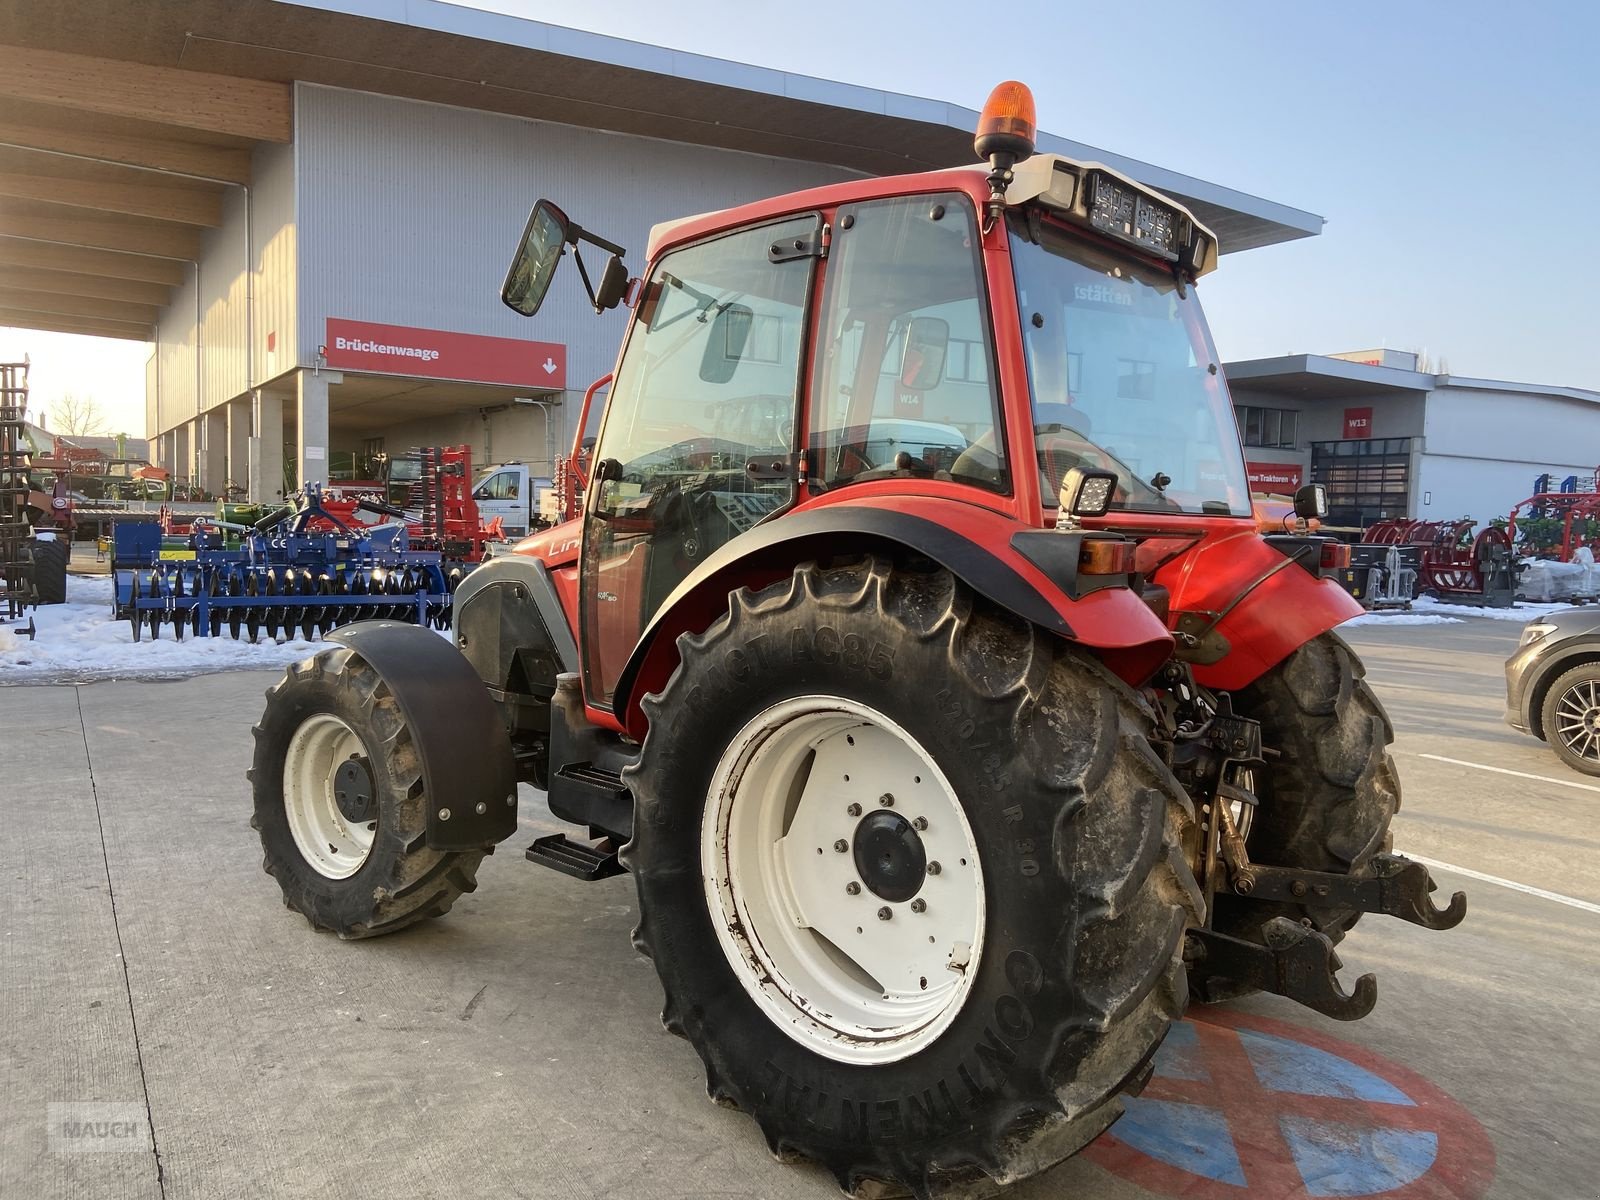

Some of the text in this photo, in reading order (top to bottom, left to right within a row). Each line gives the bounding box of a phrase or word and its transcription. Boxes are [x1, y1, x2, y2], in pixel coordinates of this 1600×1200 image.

[336, 337, 439, 361] Brückenwaage
[1349, 419, 1367, 427] W13
[1260, 474, 1289, 483] Traktoren
[549, 539, 580, 556] Lin
[790, 626, 897, 682] AC85
[1002, 802, 1024, 826] R
